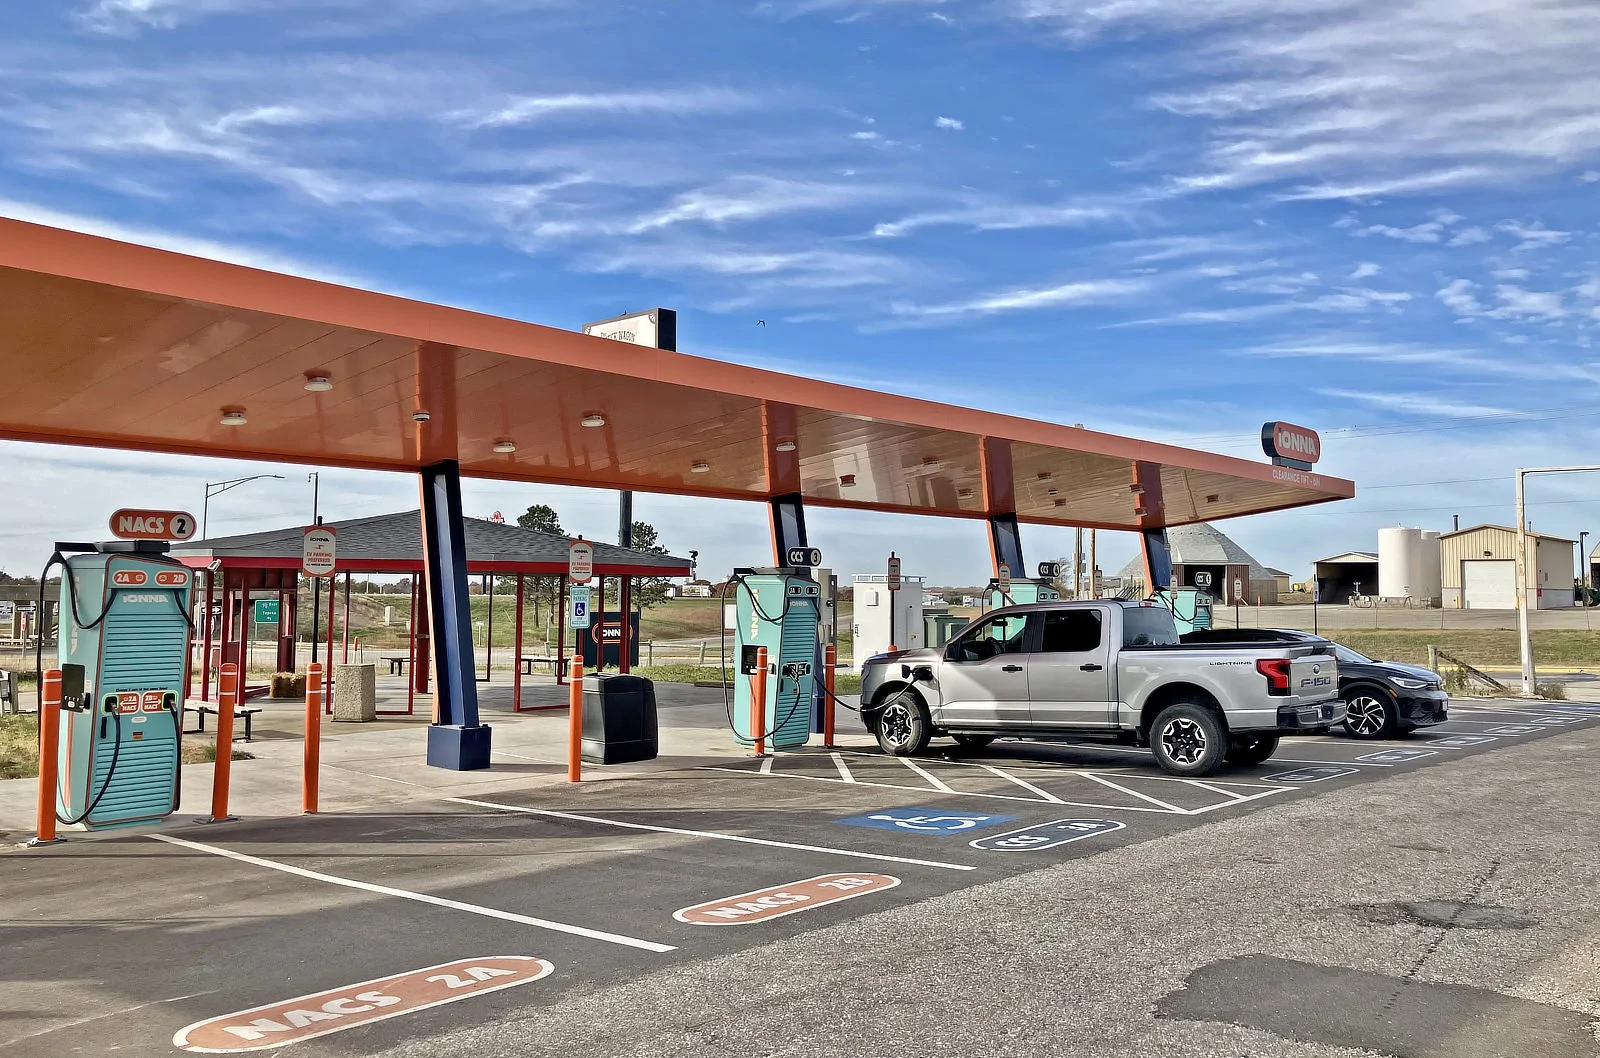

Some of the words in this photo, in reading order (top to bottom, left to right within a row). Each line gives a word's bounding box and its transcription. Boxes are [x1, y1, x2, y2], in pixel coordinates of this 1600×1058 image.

[1273, 469, 1300, 485] CLEARANCE
[119, 516, 164, 534] NACS
[176, 518, 186, 534] 2
[791, 552, 803, 562] CCS
[814, 553, 818, 562] 3
[1040, 566, 1049, 574] CCS
[116, 574, 129, 582] 2A
[173, 575, 184, 583] 2B
[1300, 676, 1331, 688] F-150
[702, 892, 811, 919] NACS
[818, 877, 874, 890] 2B
[222, 991, 402, 1041] NACS
[425, 966, 517, 989] 2A
